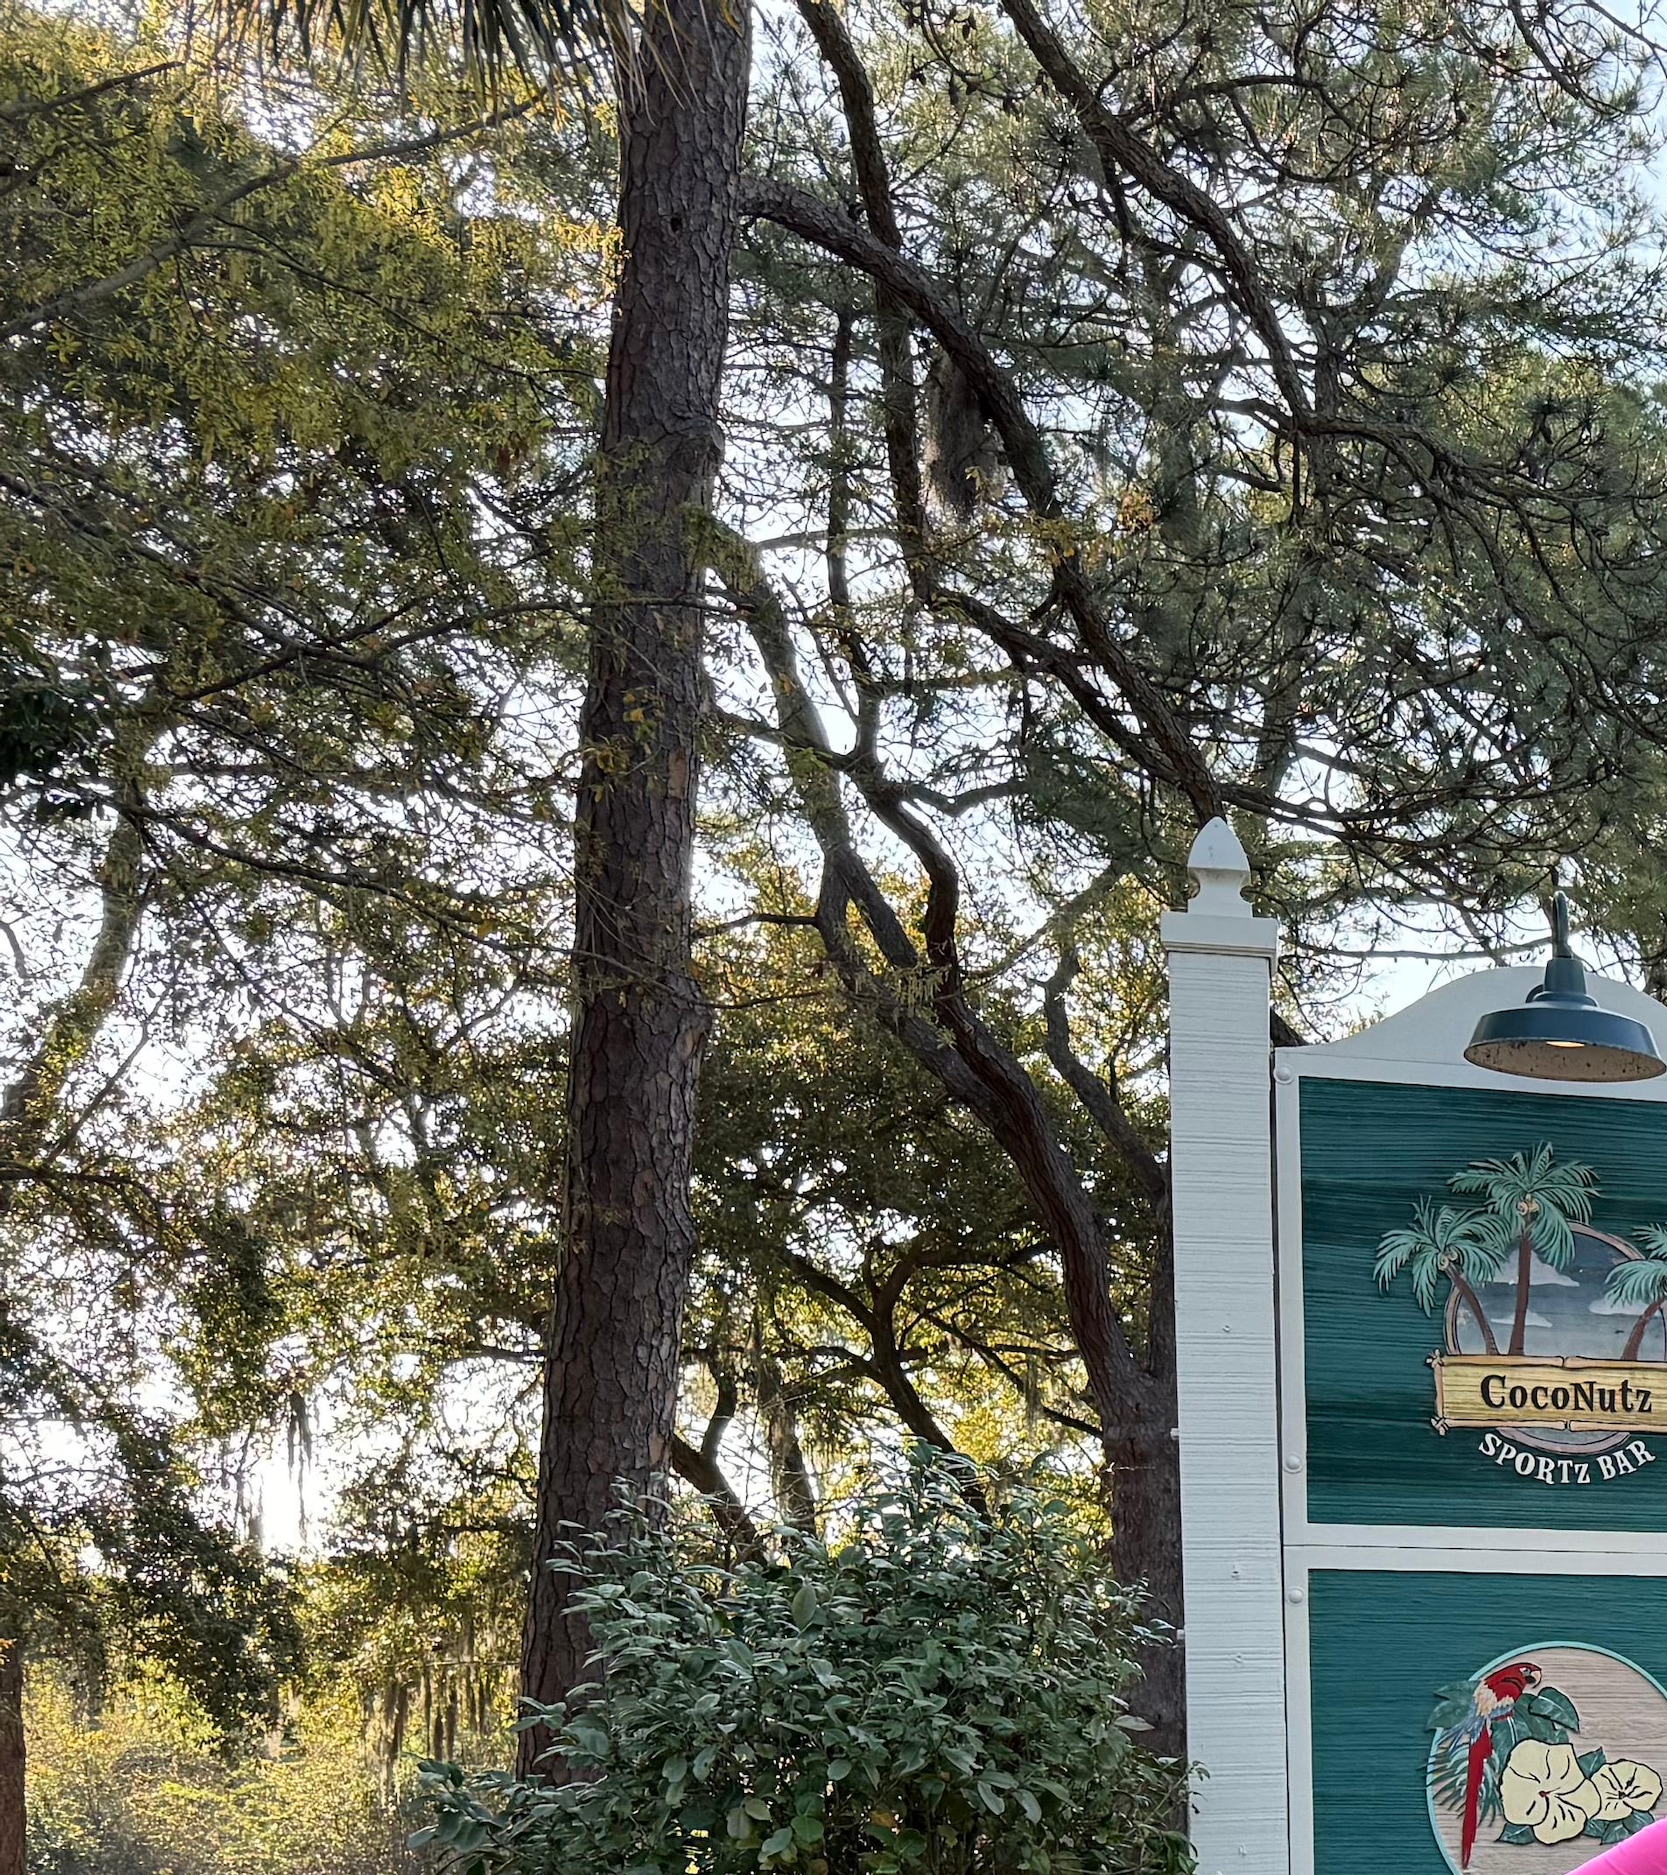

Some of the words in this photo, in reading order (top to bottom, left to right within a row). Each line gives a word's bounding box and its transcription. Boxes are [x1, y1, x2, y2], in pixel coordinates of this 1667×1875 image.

[1480, 1374, 1652, 1413] CocoNutz
[1478, 1433, 1591, 1485] SPORTZ
[1596, 1440, 1656, 1481] BAR
